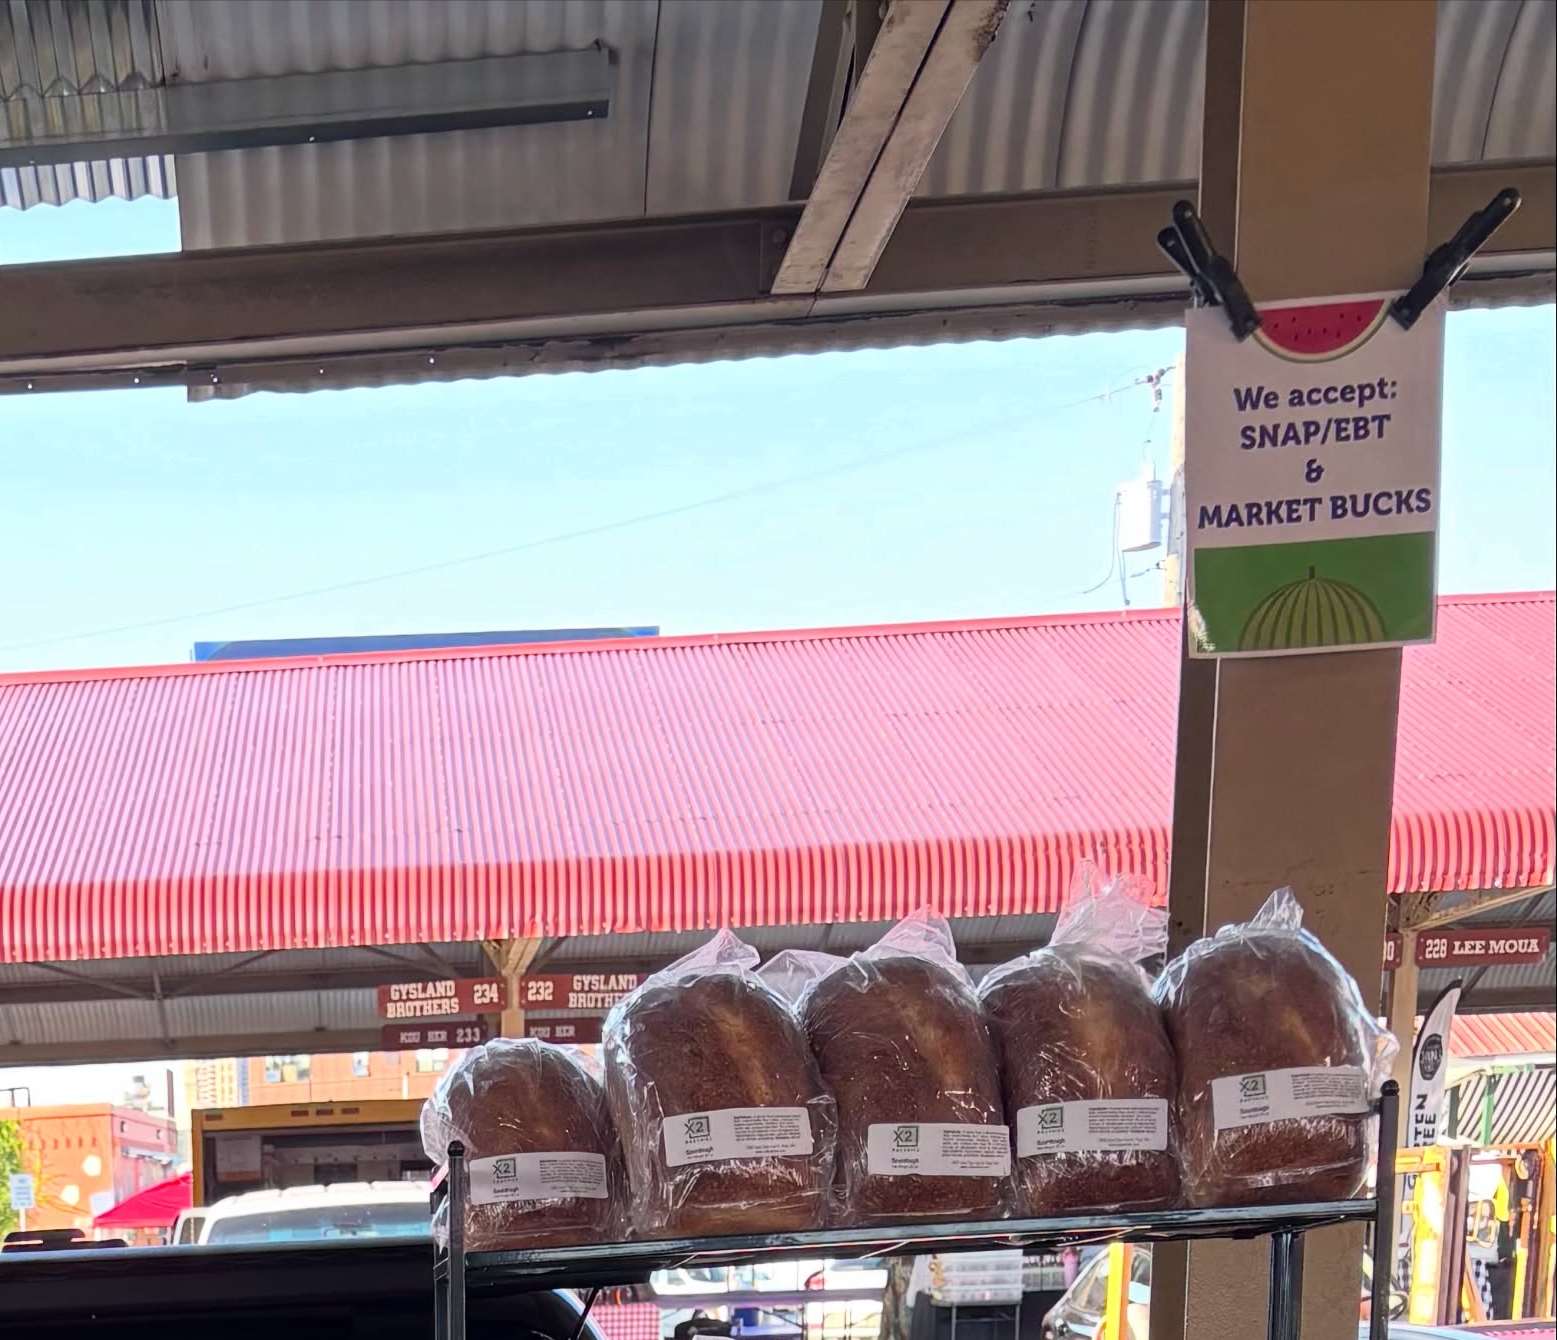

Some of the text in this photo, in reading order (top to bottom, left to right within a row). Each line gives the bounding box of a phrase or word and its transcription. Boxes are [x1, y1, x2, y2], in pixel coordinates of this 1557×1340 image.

[1233, 377, 1398, 412] We accept:
[1240, 414, 1391, 450] SNAP/EBT
[1304, 458, 1325, 483] &
[1197, 488, 1432, 529] MARKET BUCKS
[1425, 938, 1540, 959] 228 LEE MOUA
[390, 980, 499, 1005] GYSLAND 234
[527, 974, 638, 1001] 232 GYSLAND
[386, 998, 460, 1018] BROTHERS
[456, 1027, 481, 1043] 233
